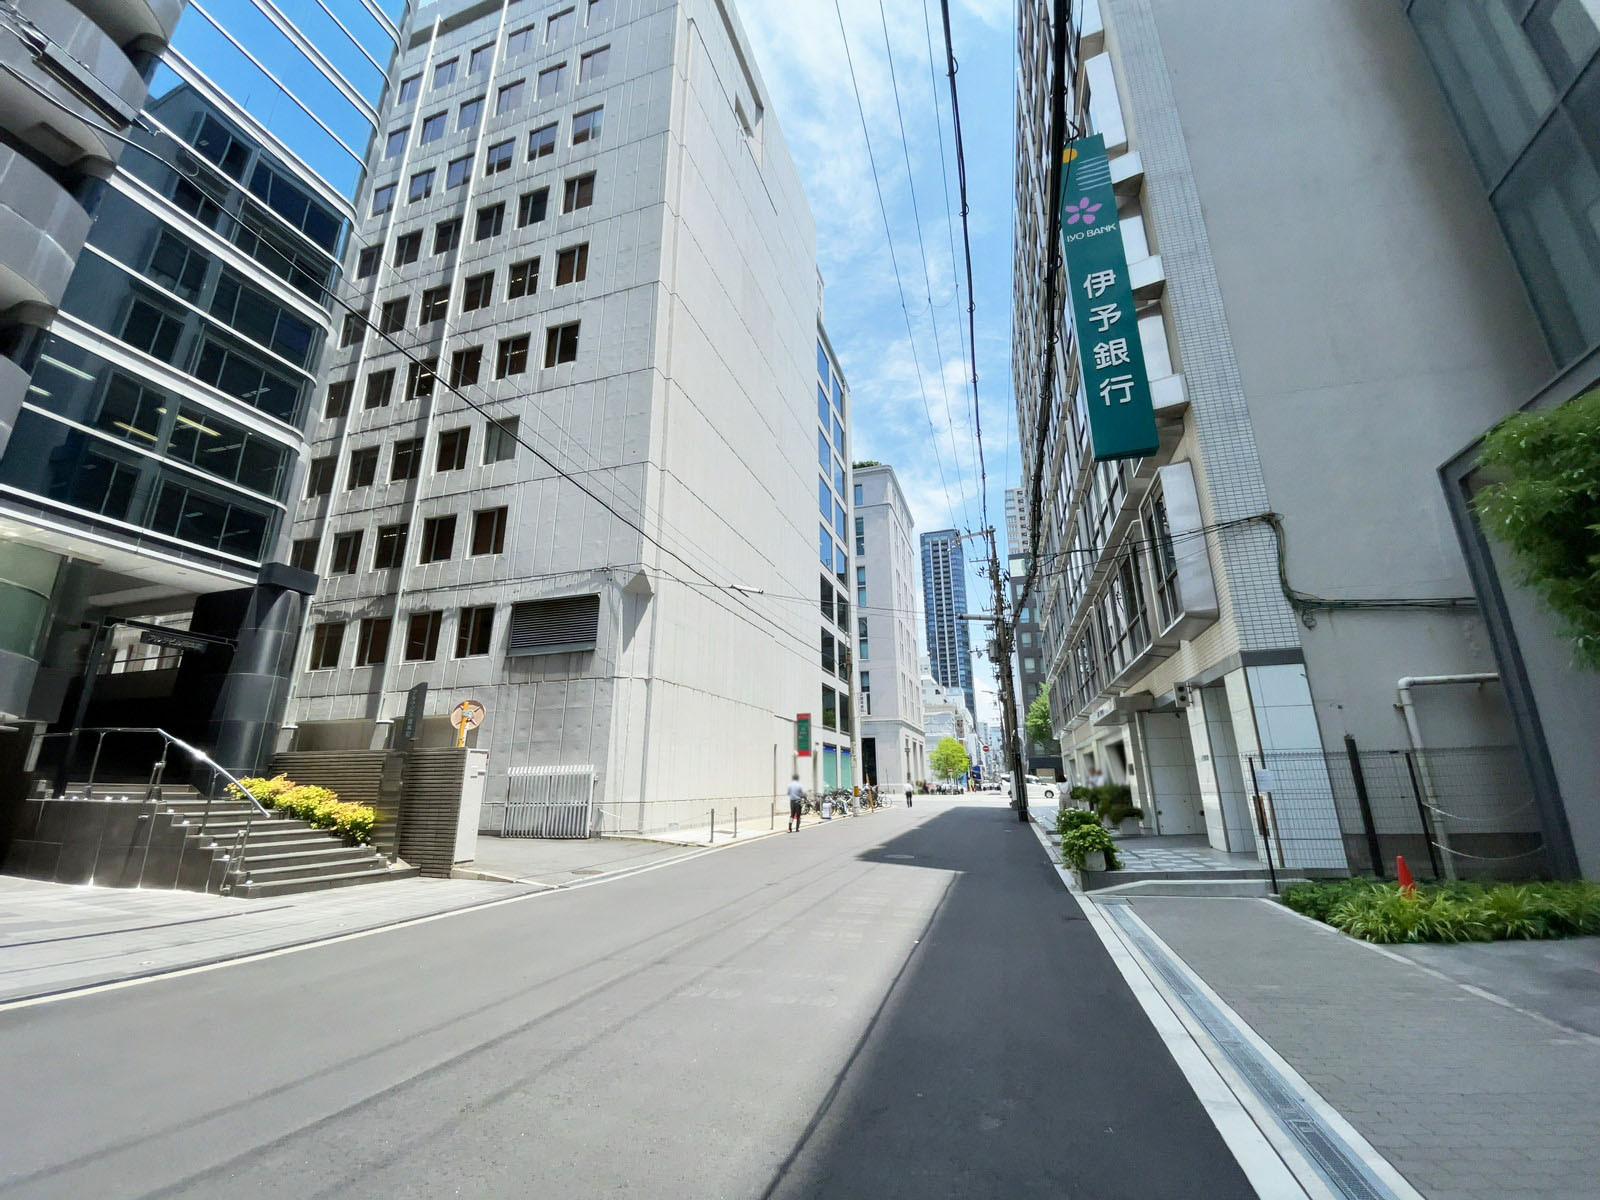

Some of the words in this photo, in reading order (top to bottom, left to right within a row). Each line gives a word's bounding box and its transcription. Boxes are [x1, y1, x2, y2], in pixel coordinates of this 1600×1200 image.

[1066, 232, 1084, 242] IYO
[1086, 223, 1116, 237] BANK
[1083, 269, 1134, 405] 伊予銀行
